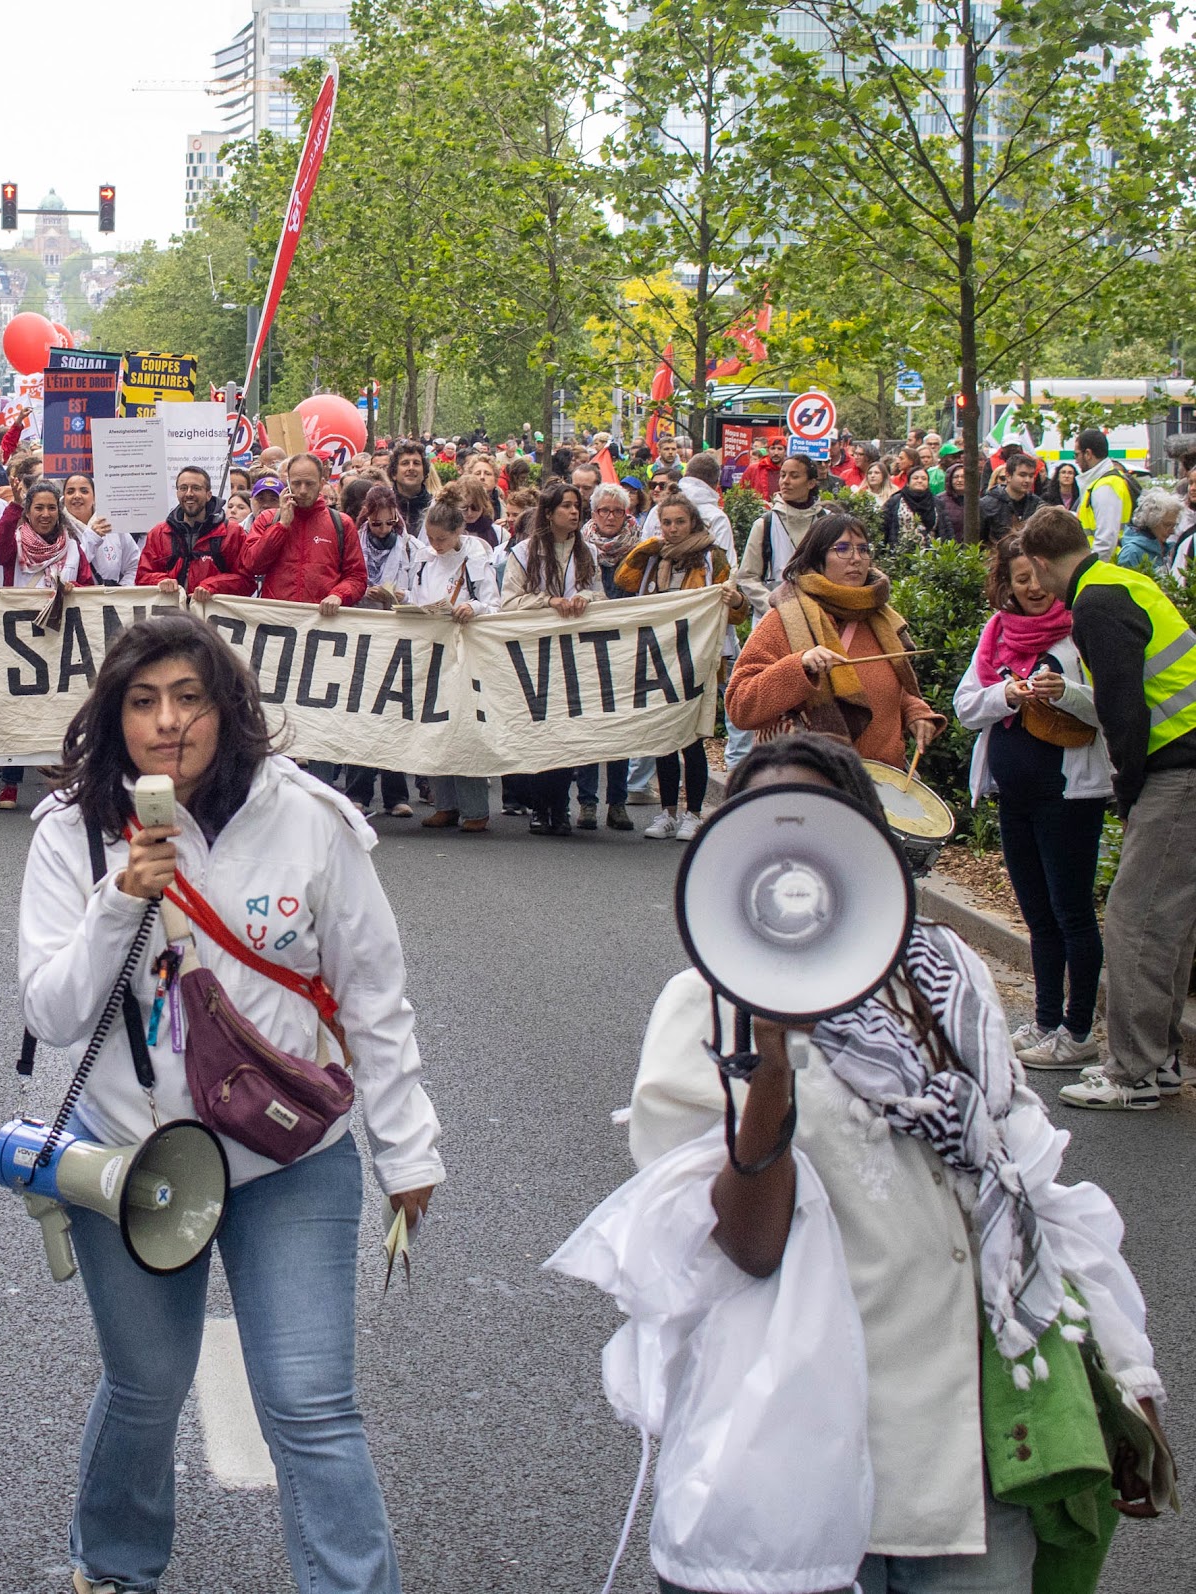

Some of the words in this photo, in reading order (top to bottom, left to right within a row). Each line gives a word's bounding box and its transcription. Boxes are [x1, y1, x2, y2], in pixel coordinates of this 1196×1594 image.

[141, 359, 180, 373] COUPES
[47, 373, 73, 389] L'ÉTAT
[76, 377, 86, 388] DE
[90, 376, 112, 388] DROIT
[131, 372, 188, 388] SANITAIRES
[68, 398, 88, 413] EST
[136, 407, 156, 418] SOC
[797, 408, 827, 427] 67
[63, 434, 92, 448] POUR
[56, 458, 68, 471] LA
[71, 458, 92, 471] SAN
[505, 619, 704, 722] VITAL
